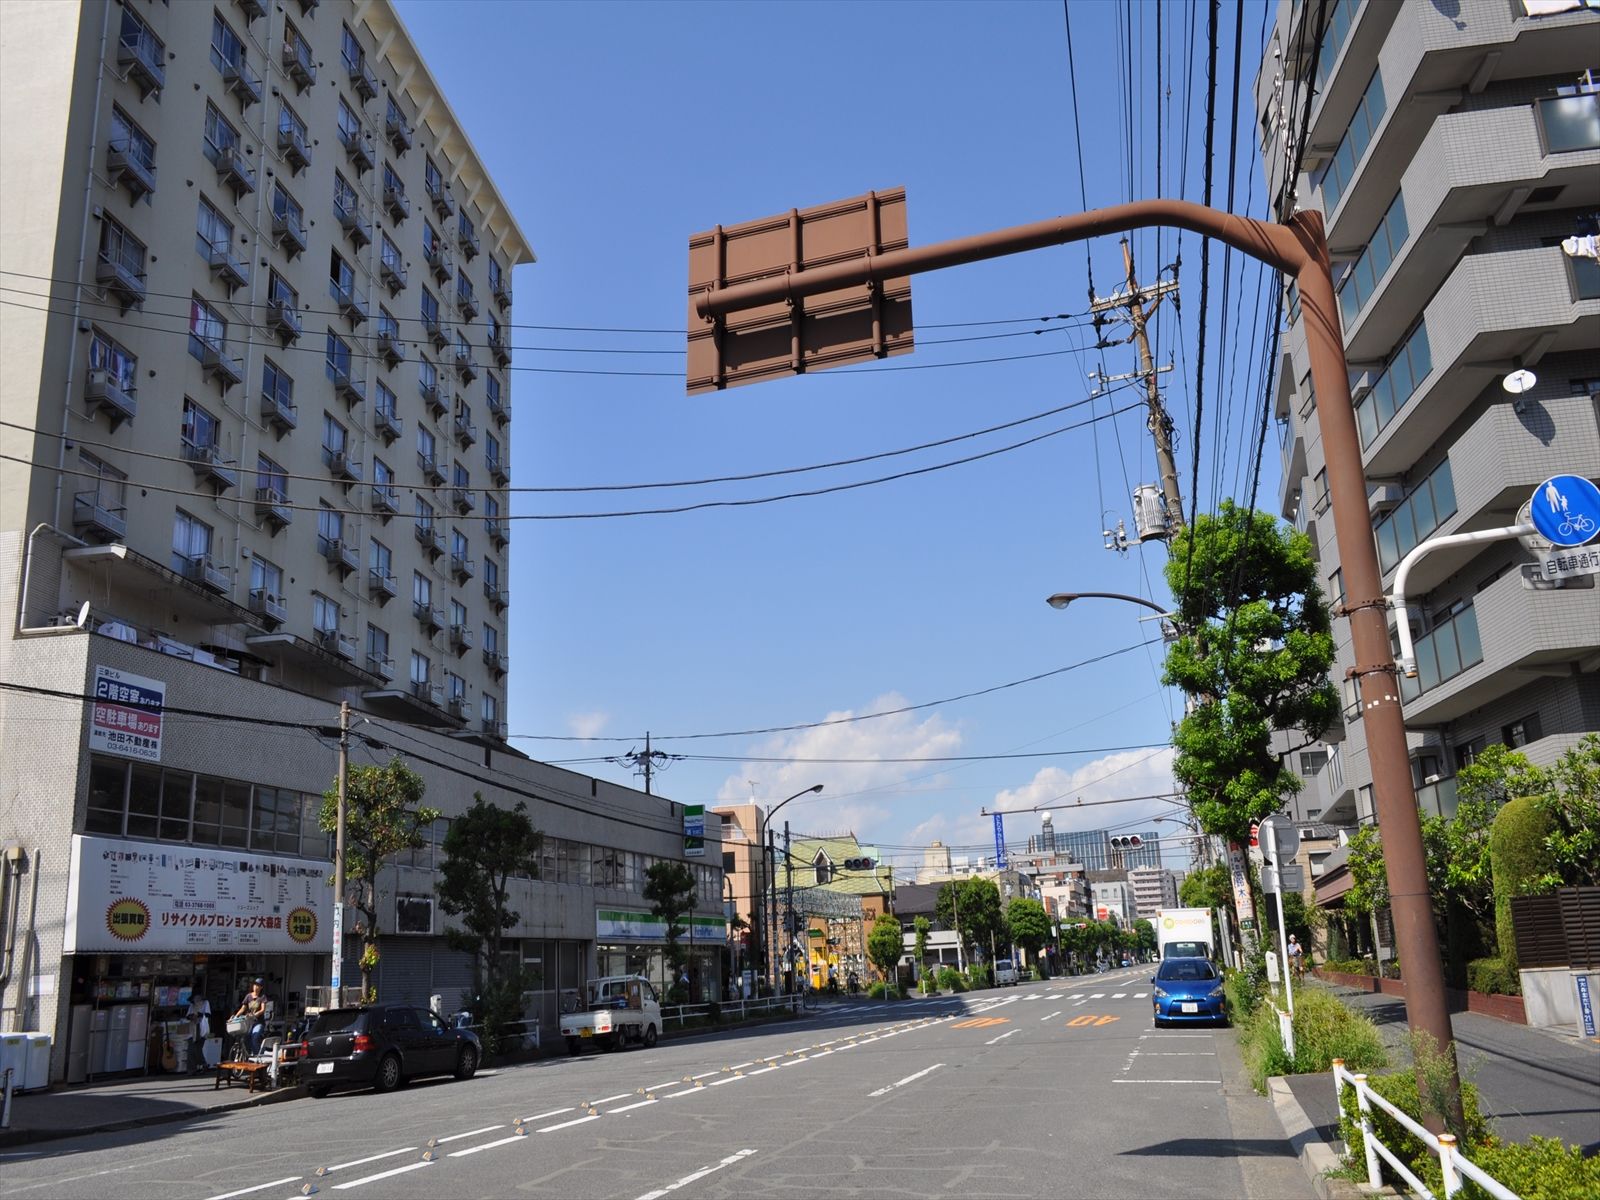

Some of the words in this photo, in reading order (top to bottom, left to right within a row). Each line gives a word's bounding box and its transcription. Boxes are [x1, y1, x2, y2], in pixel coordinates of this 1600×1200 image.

[1546, 551, 1600, 575] 自転車通行
[112, 912, 145, 925] 出張買取
[161, 911, 282, 929] リサイクルプロショップ大森店
